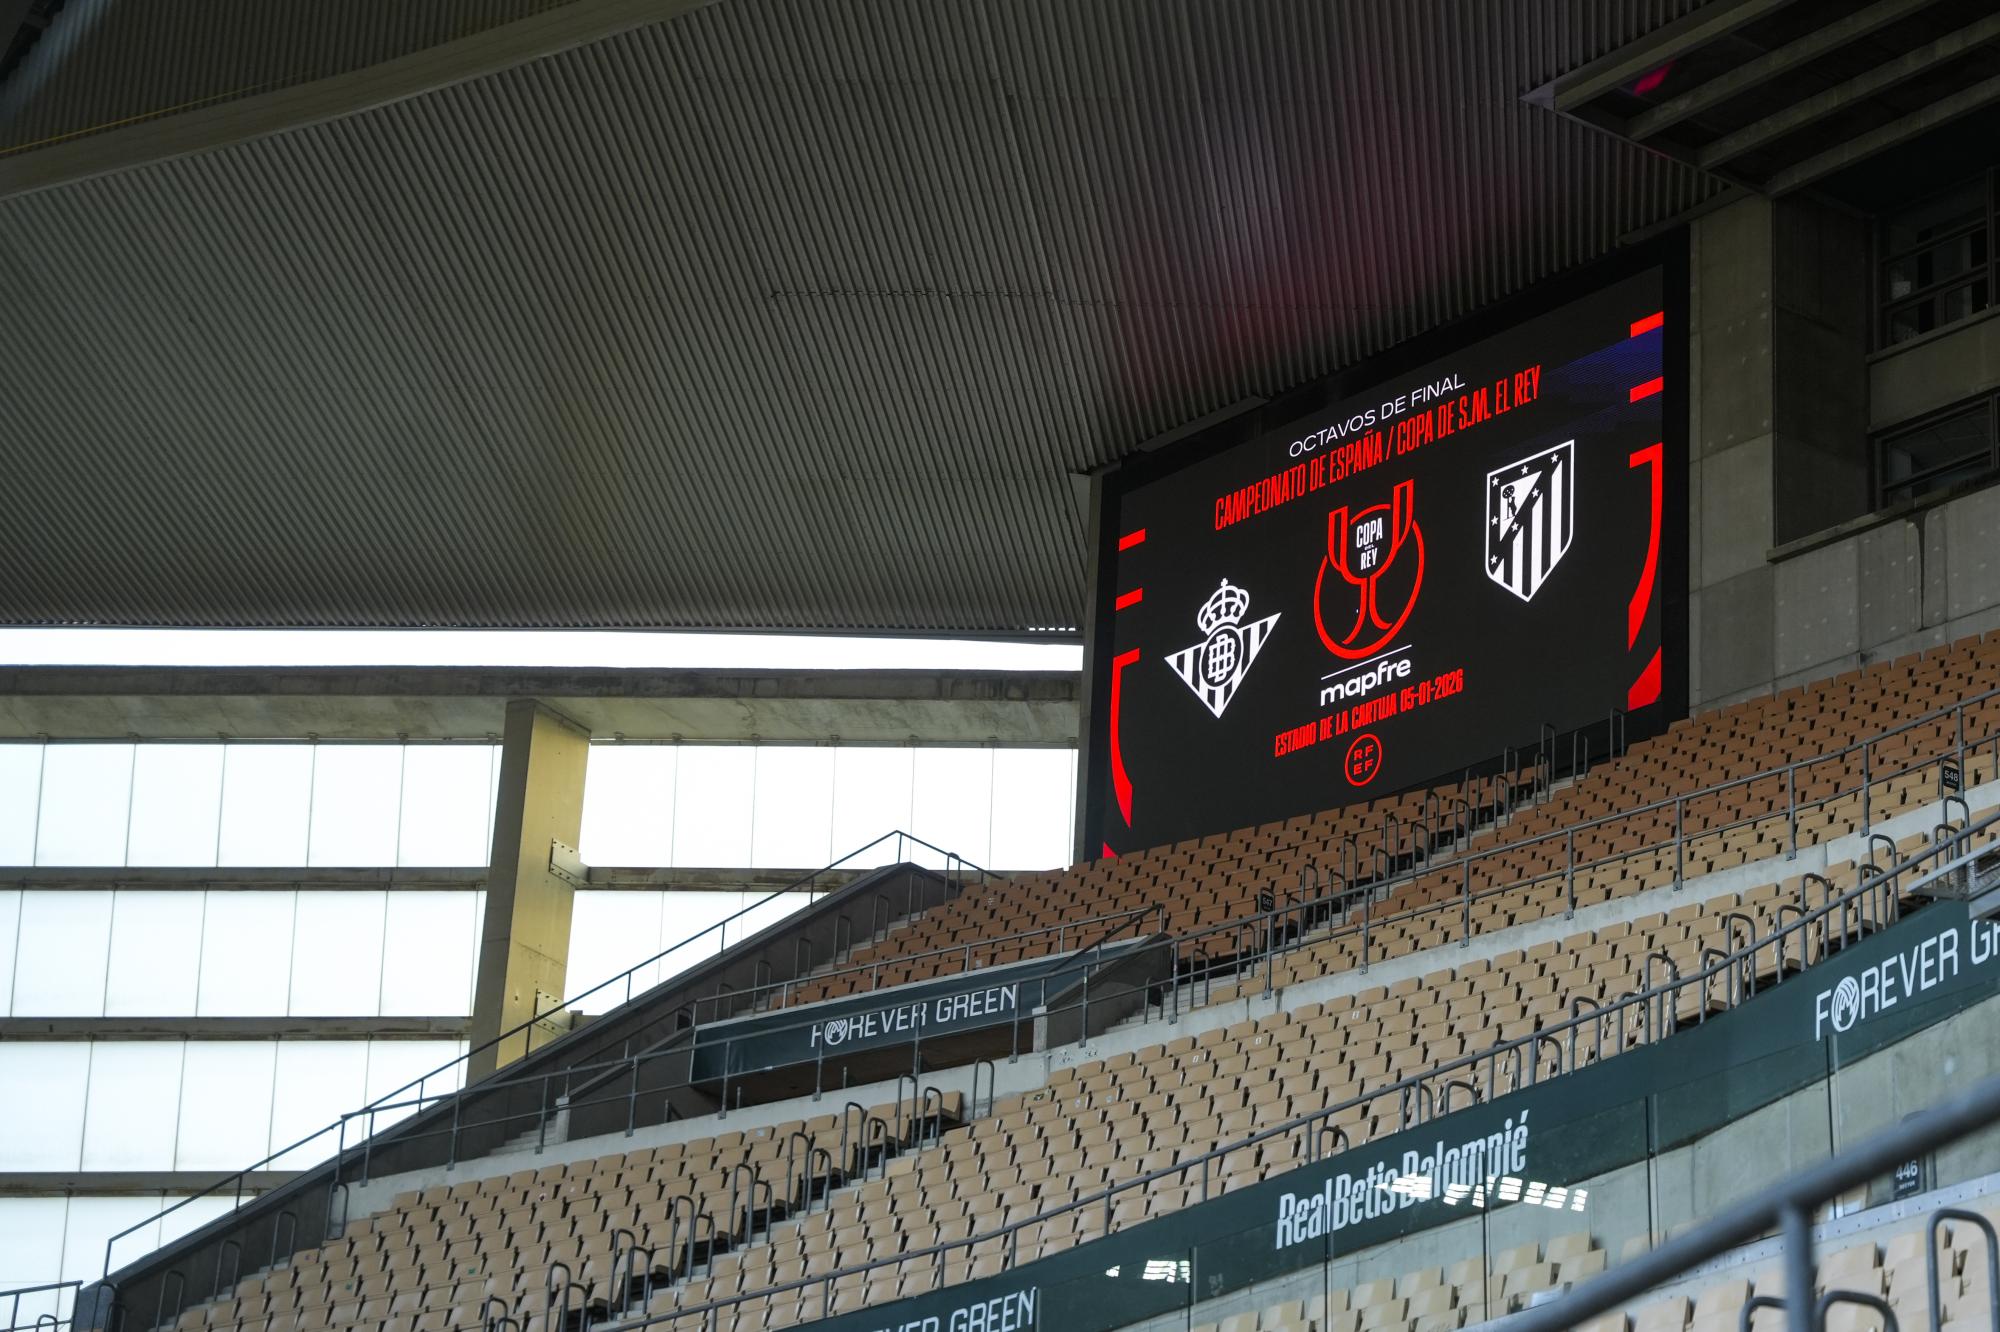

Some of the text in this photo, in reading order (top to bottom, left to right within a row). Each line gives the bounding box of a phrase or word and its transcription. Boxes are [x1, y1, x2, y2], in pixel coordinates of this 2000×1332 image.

[1289, 373, 1466, 458] OCTAVOS DE FINAL
[1215, 463, 1307, 531] CAMPEONATO
[1309, 454, 1327, 492] DE
[1329, 428, 1383, 484] ESPAÑA
[1396, 409, 1434, 456] COPA
[1437, 400, 1456, 440] DE
[1458, 387, 1493, 431] S.M.
[1495, 378, 1512, 415] EL
[1513, 364, 1541, 408] REY
[1356, 517, 1383, 549] COPA
[1360, 547, 1378, 571] REY
[1320, 658, 1412, 707] mapfre
[1274, 668, 1464, 758] ESTADIO DE LA CARTUJA 05-01-2026
[936, 984, 1017, 1023] GREEN
[1895, 1159, 1918, 1180] 446
